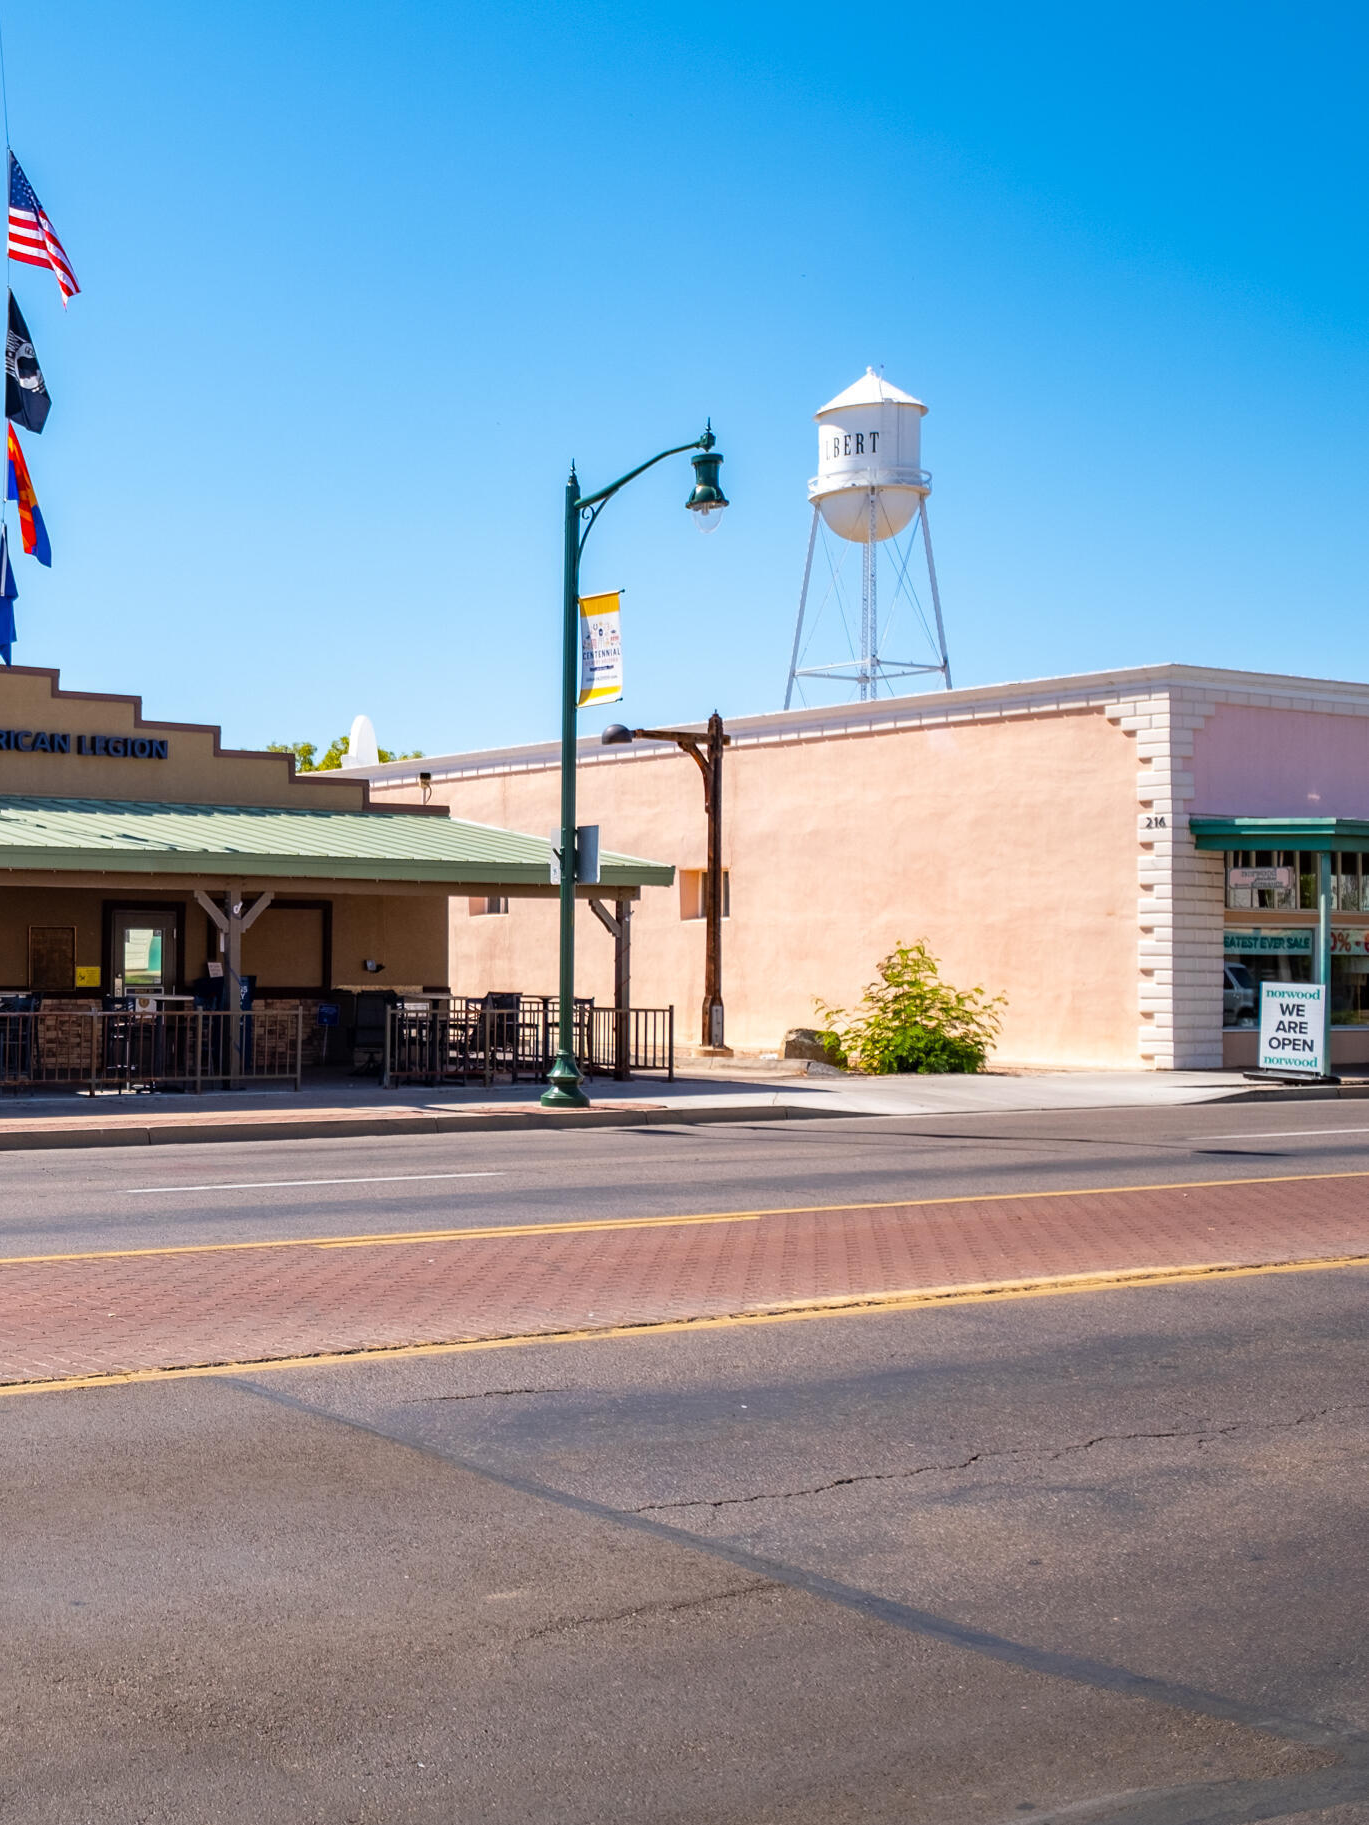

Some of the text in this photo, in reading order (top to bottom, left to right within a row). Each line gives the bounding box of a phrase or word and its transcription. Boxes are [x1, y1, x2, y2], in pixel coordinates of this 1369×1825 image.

[583, 648, 621, 660] CENTENNIAL
[77, 735, 168, 760] LEGION
[1260, 936, 1285, 949] EVER
[1287, 936, 1310, 949] SALE
[1266, 989, 1321, 1000] norwood
[1279, 1003, 1306, 1017] WE
[1275, 1020, 1308, 1034] ARE
[1268, 1037, 1314, 1052] OPEN
[1263, 1056, 1318, 1068] norwood
